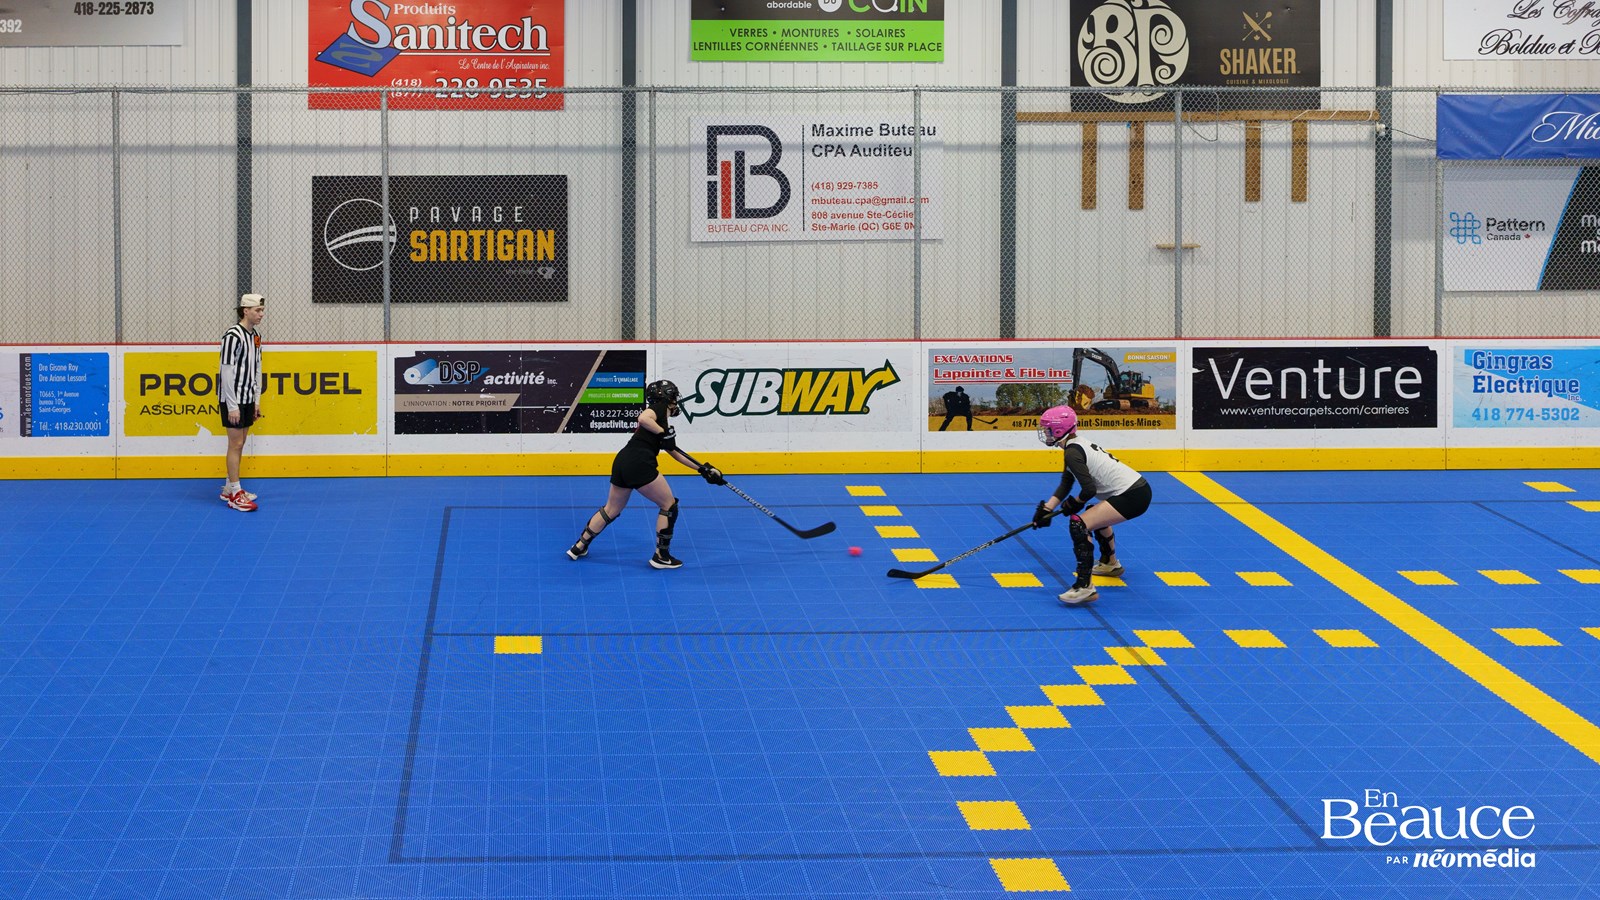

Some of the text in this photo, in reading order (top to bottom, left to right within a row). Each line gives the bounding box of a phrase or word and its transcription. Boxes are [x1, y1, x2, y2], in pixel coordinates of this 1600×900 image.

[74, 1, 154, 15] 418-225-2873
[393, 3, 456, 15] Produits
[766, 1, 812, 9] abordable
[1506, 0, 1544, 20] Les
[347, 0, 550, 51] Sanitech
[730, 28, 906, 38] VERRES MONTURES SOLAIRES
[693, 39, 942, 52] LENTILLES CORNÉENNES TAILLAGE SUR PLACE
[1478, 29, 1556, 55] Bolduc
[1558, 39, 1577, 54] et
[391, 78, 422, 88] (418)
[811, 124, 873, 137] Maxime
[811, 143, 914, 157] CPA Auditeu
[811, 181, 879, 191] (418) 929-7385
[811, 196, 930, 206] mbuteau.cpa@gmail.cm
[409, 206, 523, 223] PAVAGE
[830, 211, 864, 219] avenue
[707, 224, 747, 233] BUTEAU
[749, 224, 769, 232] CPA
[811, 223, 855, 231] Ste-Marie
[858, 222, 879, 232] (QC)
[882, 222, 901, 230] G6E
[1486, 217, 1545, 232] Pattern
[1486, 233, 1521, 241] Canada
[409, 229, 555, 262] SARTIGAN
[934, 354, 1014, 364] EXCAVATIONS
[1472, 351, 1553, 374] Gingras
[68, 362, 78, 372] Roy
[439, 361, 480, 383] DSP
[484, 371, 545, 385] activité
[934, 367, 1071, 380] Lapointe & Fils inc
[1208, 358, 1422, 400] Venture
[139, 372, 362, 396] PROTUEL
[1472, 370, 1579, 398] Électrique
[680, 367, 900, 419] SUBWAY
[139, 404, 221, 416] ASSURAN
[475, 400, 507, 408] PRIORITÉ
[590, 410, 605, 418] 418
[1220, 405, 1410, 417] www.venturecarpets.com/carrieres
[1472, 408, 1579, 421] 418 774-5302
[55, 422, 101, 431] 418.230.0001
[590, 420, 640, 430] dspactivite.co
[1076, 418, 1161, 428] aint-Simon-les-Mines
